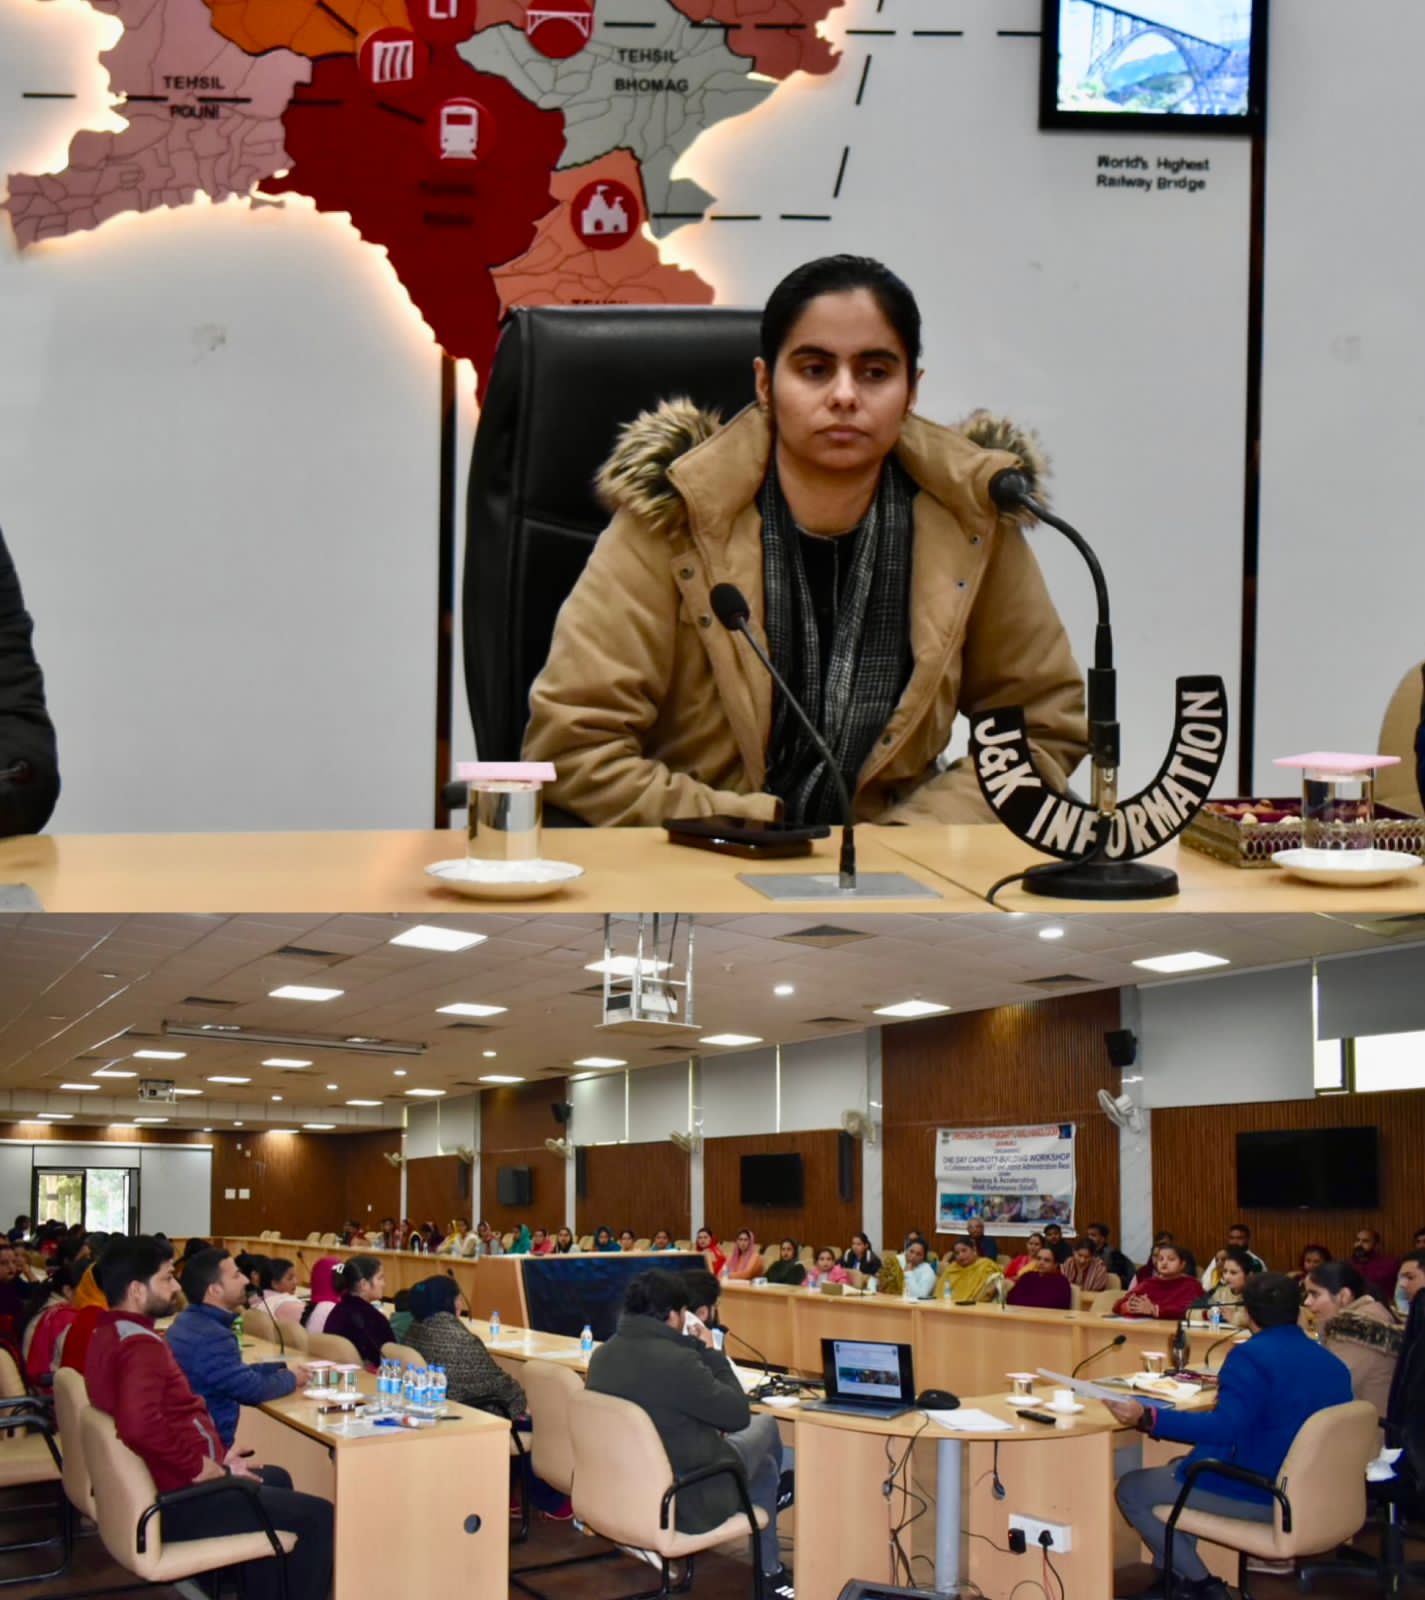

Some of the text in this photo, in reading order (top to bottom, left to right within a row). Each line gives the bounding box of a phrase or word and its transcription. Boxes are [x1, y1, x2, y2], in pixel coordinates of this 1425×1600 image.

[617, 48, 680, 63] TEHSIL
[162, 75, 226, 90] TEHSIL
[615, 78, 689, 93] BHOMAG
[1097, 155, 1210, 174] World's Highest
[1096, 174, 1206, 192] Railway Bridge
[974, 690, 1223, 860] J&K INFORMATION
[1029, 1152, 1070, 1162] WORKSHOP
